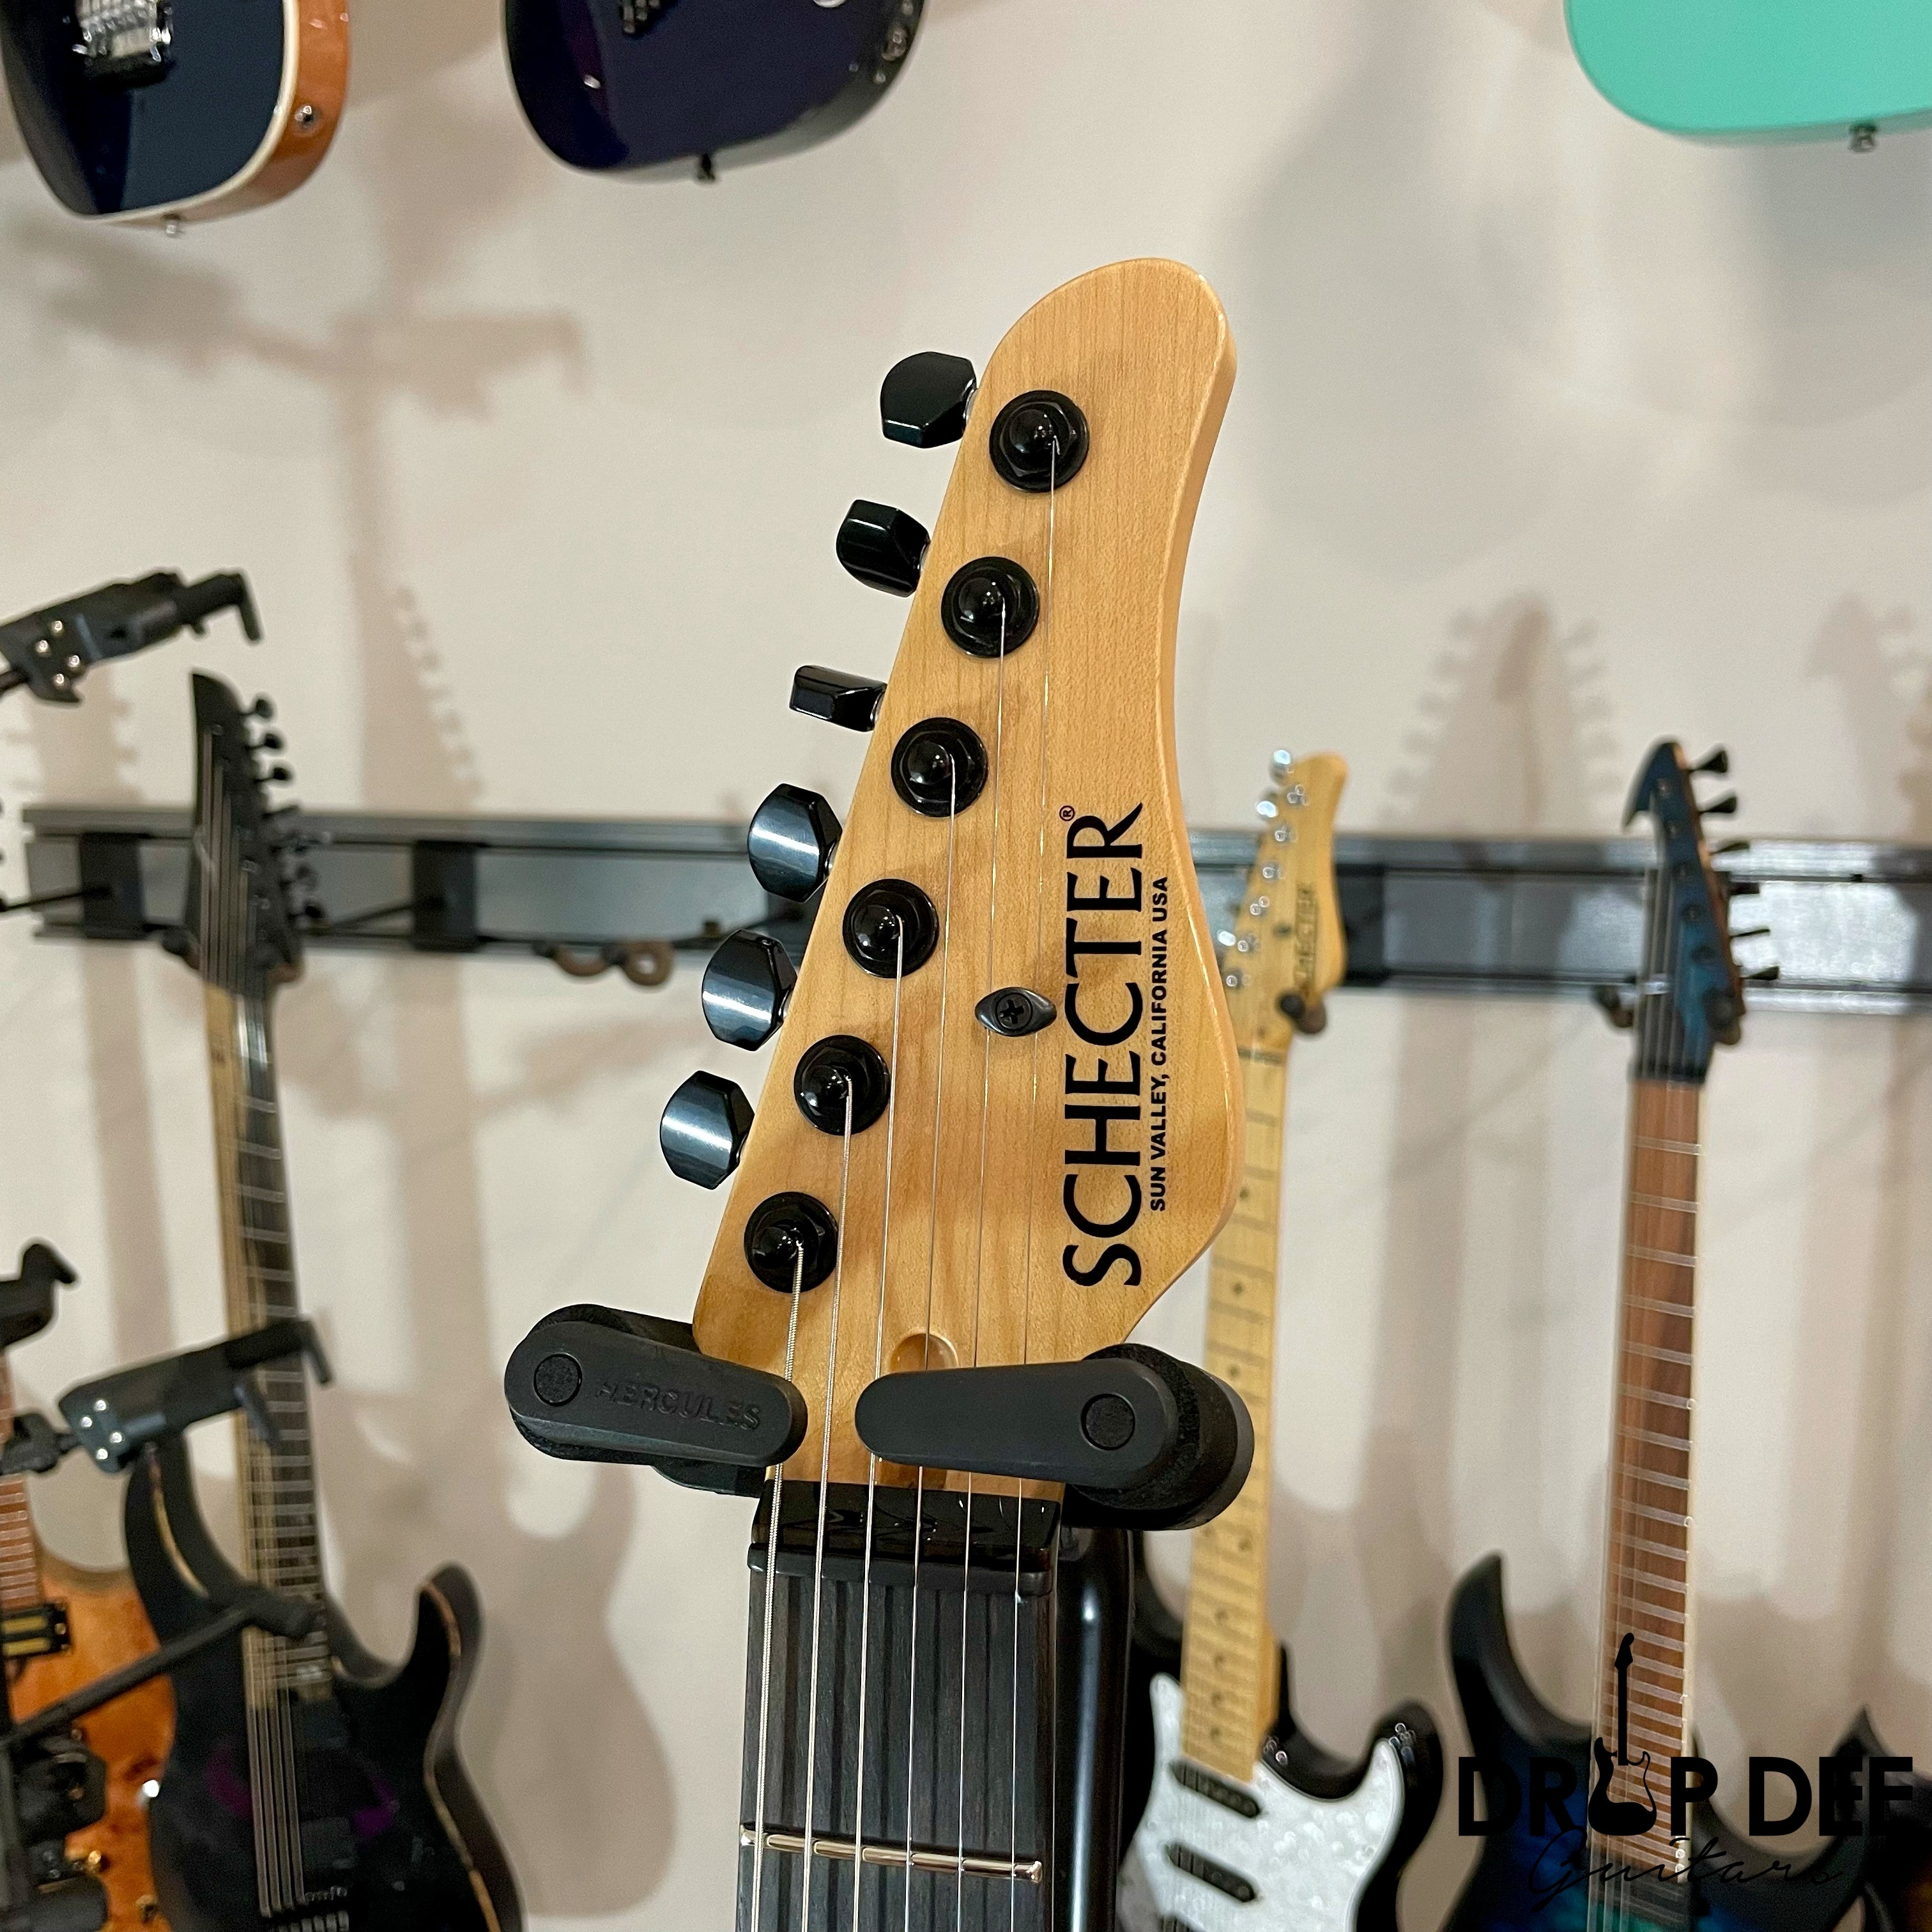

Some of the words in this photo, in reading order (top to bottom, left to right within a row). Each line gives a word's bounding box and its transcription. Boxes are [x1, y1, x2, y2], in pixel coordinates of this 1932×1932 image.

[1151, 876, 1169, 923] USA
[1150, 928, 1168, 1067] CALIFORNIA
[1149, 1074, 1170, 1161] VALLEY,
[1149, 1166, 1167, 1213] SUN
[594, 1380, 762, 1430] HERCULES
